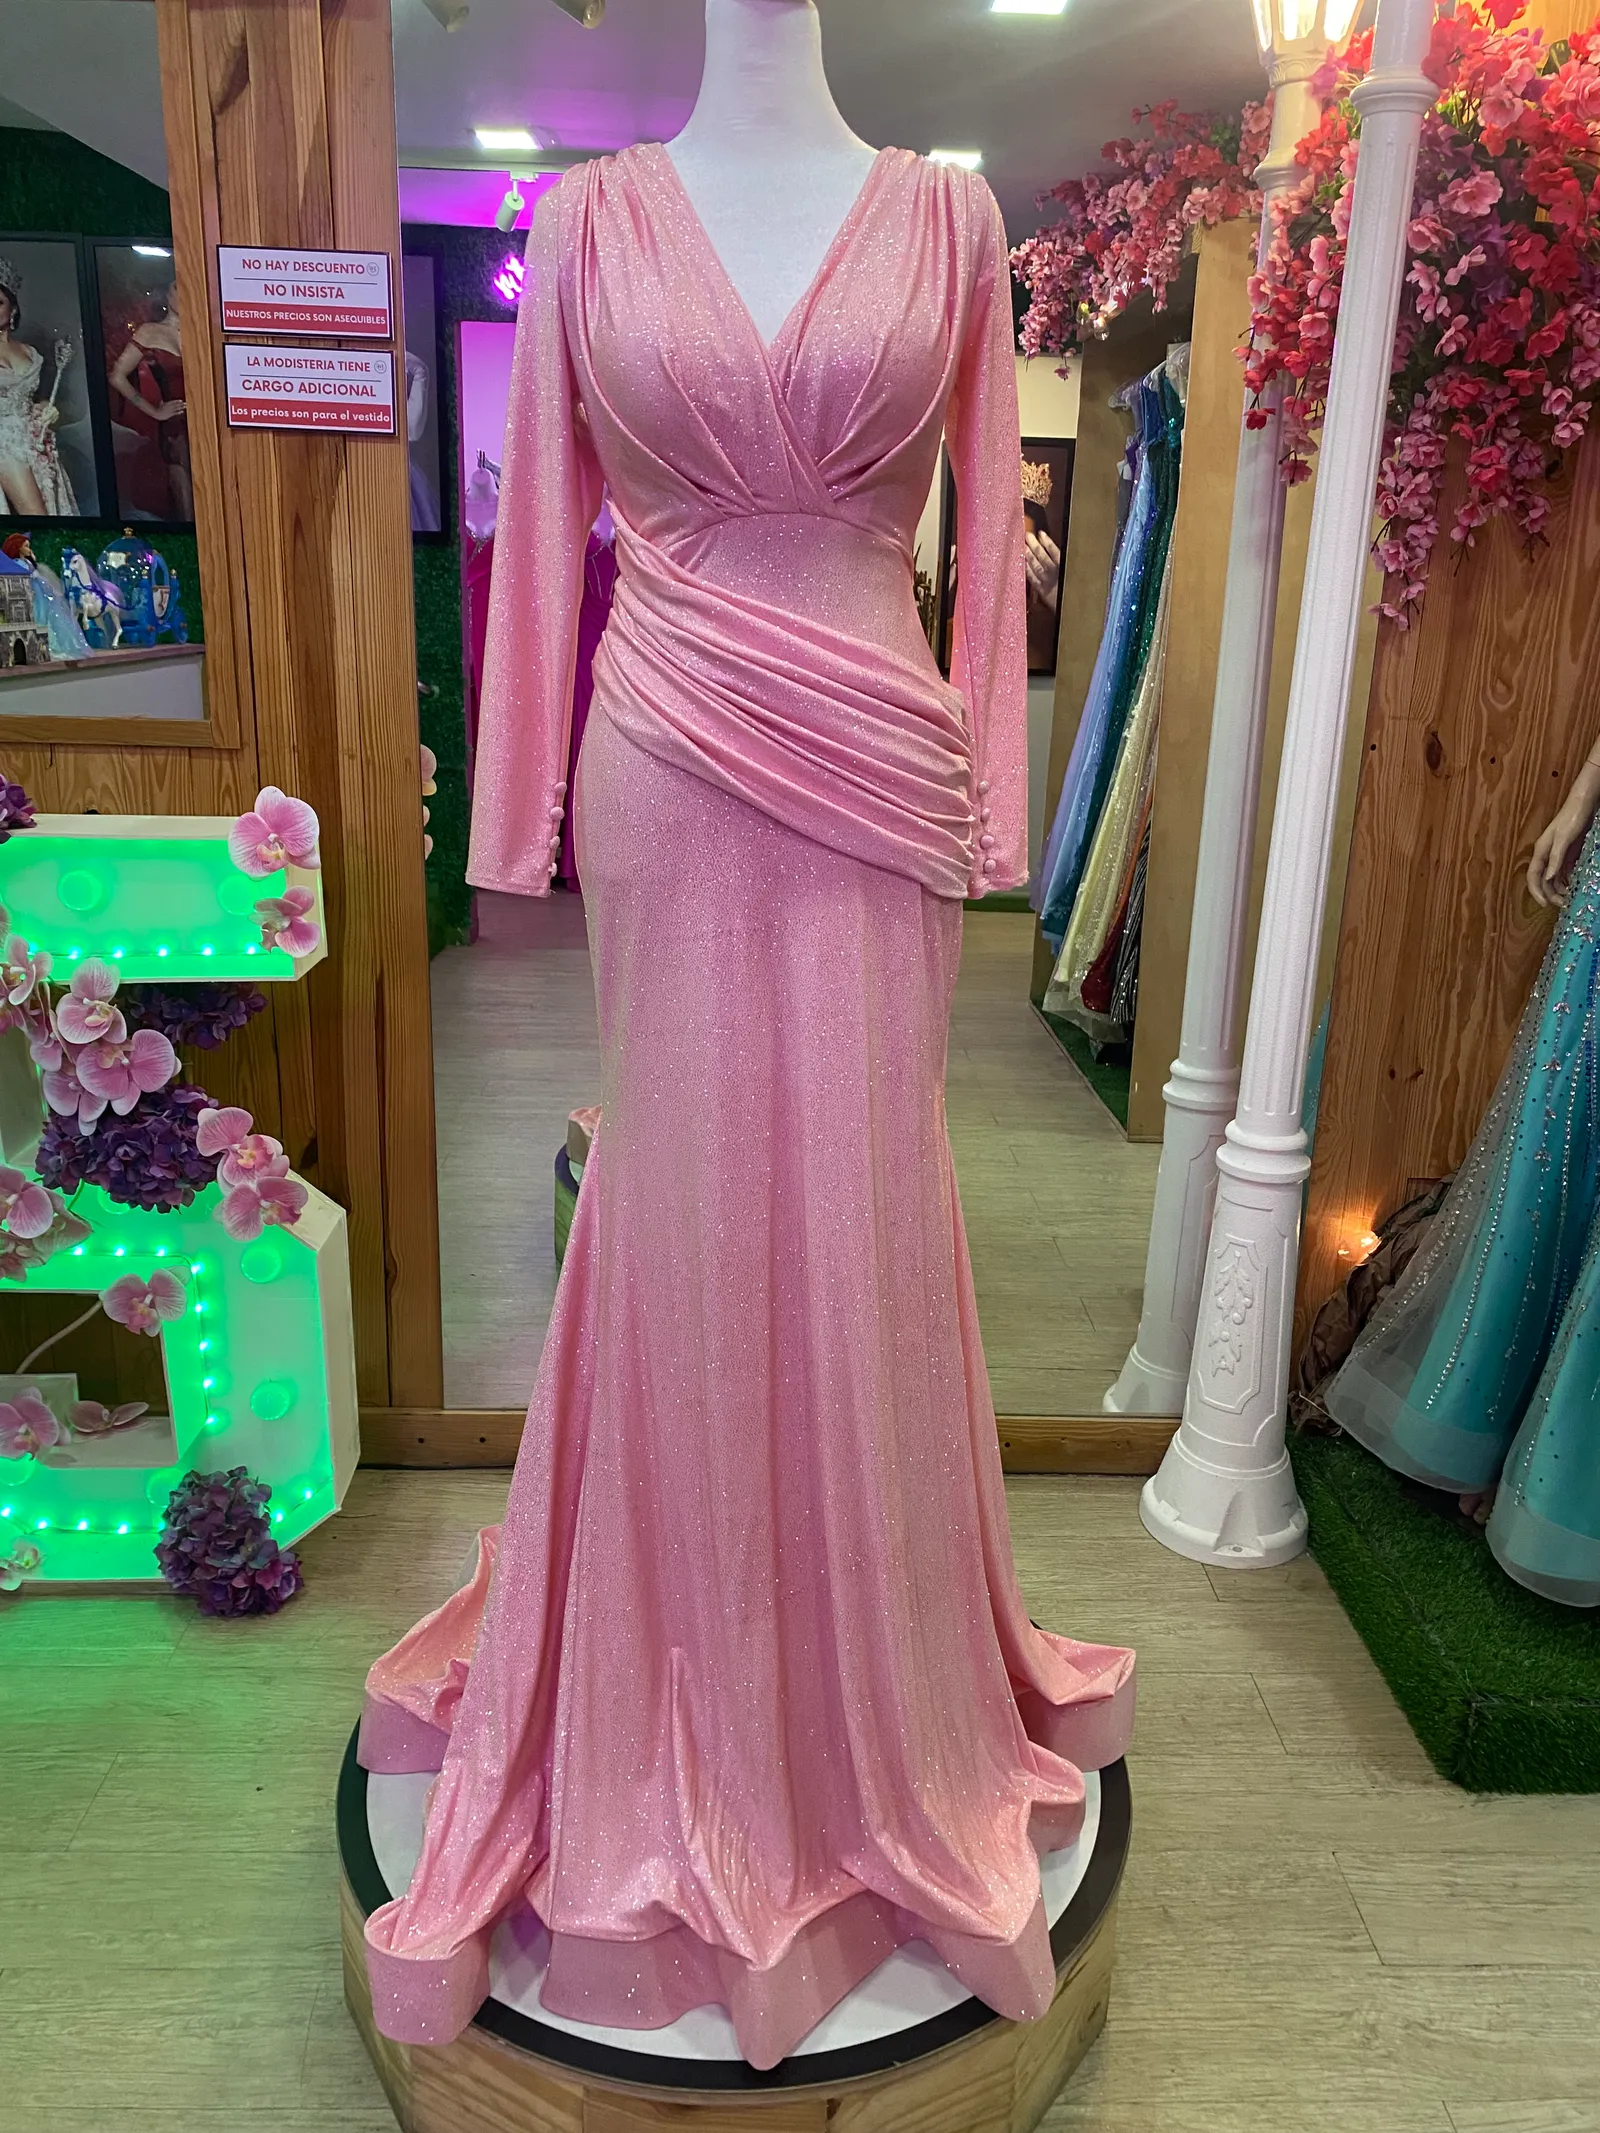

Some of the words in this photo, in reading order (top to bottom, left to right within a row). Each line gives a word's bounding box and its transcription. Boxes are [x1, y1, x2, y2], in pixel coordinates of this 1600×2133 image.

[242, 259, 261, 270] NO
[266, 260, 289, 271] HAY
[293, 262, 365, 274] DESCUENTO
[264, 284, 286, 296] NO
[292, 286, 344, 299] INSISTA
[226, 310, 271, 319] NUESTROS
[274, 312, 311, 321] PRECIOS
[313, 314, 332, 322] SON
[335, 315, 386, 325] ASEQUIBLES
[247, 356, 260, 367] LA
[264, 358, 334, 370] MODISTERIA
[338, 361, 370, 372] TIENE
[242, 379, 294, 393] CARGO
[298, 382, 376, 397] ADICIONAL
[232, 405, 247, 416] Los
[251, 408, 289, 418] precios
[292, 410, 309, 418] son
[313, 412, 337, 421] para
[340, 411, 349, 420] el
[353, 411, 390, 423] vestido
